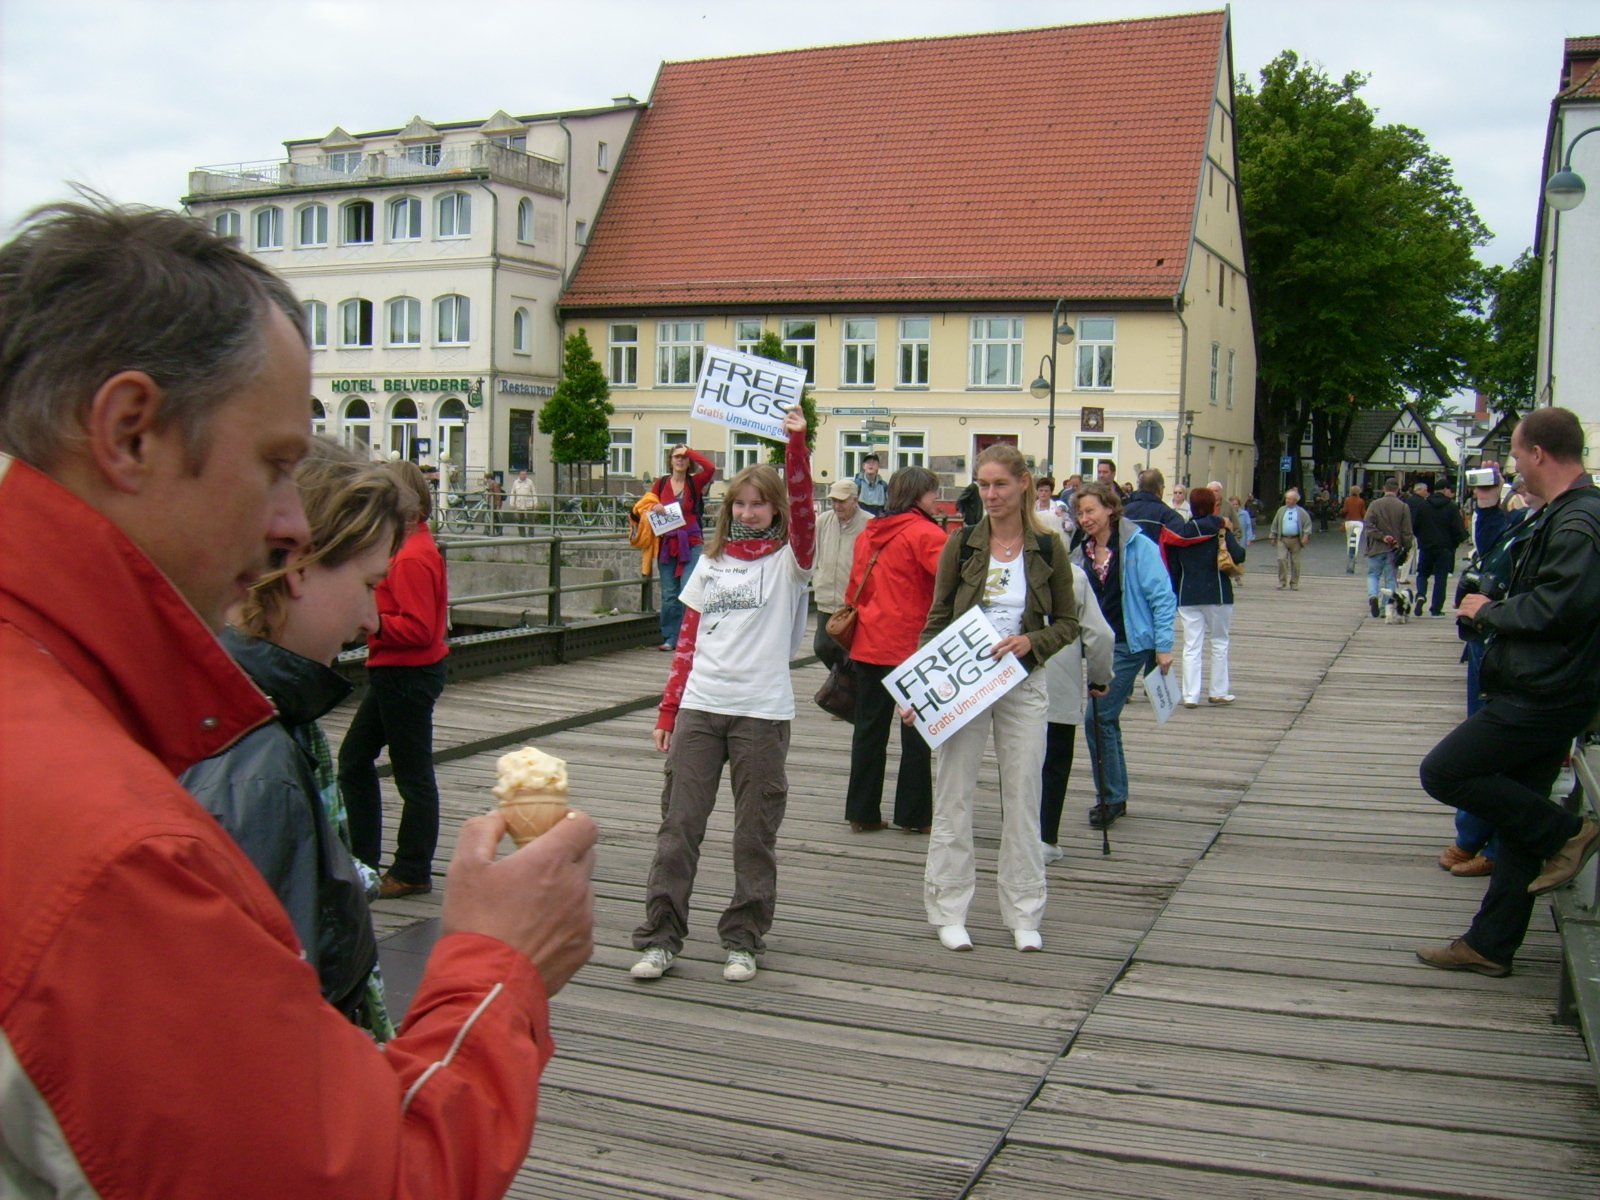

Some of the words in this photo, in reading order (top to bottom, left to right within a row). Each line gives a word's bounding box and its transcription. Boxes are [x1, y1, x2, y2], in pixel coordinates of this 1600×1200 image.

[331, 379, 376, 393] HOTEL
[384, 379, 470, 392] BELVEDERE
[501, 379, 556, 396] Restaurant
[707, 357, 799, 399] FREE
[697, 404, 724, 419] Gratis
[700, 379, 793, 421] HUGS
[653, 514, 680, 528] HUGS
[895, 618, 989, 700] FREE
[911, 642, 1001, 722] HUGS
[928, 713, 956, 736] Gratis
[954, 665, 1016, 716] Umarmungen
